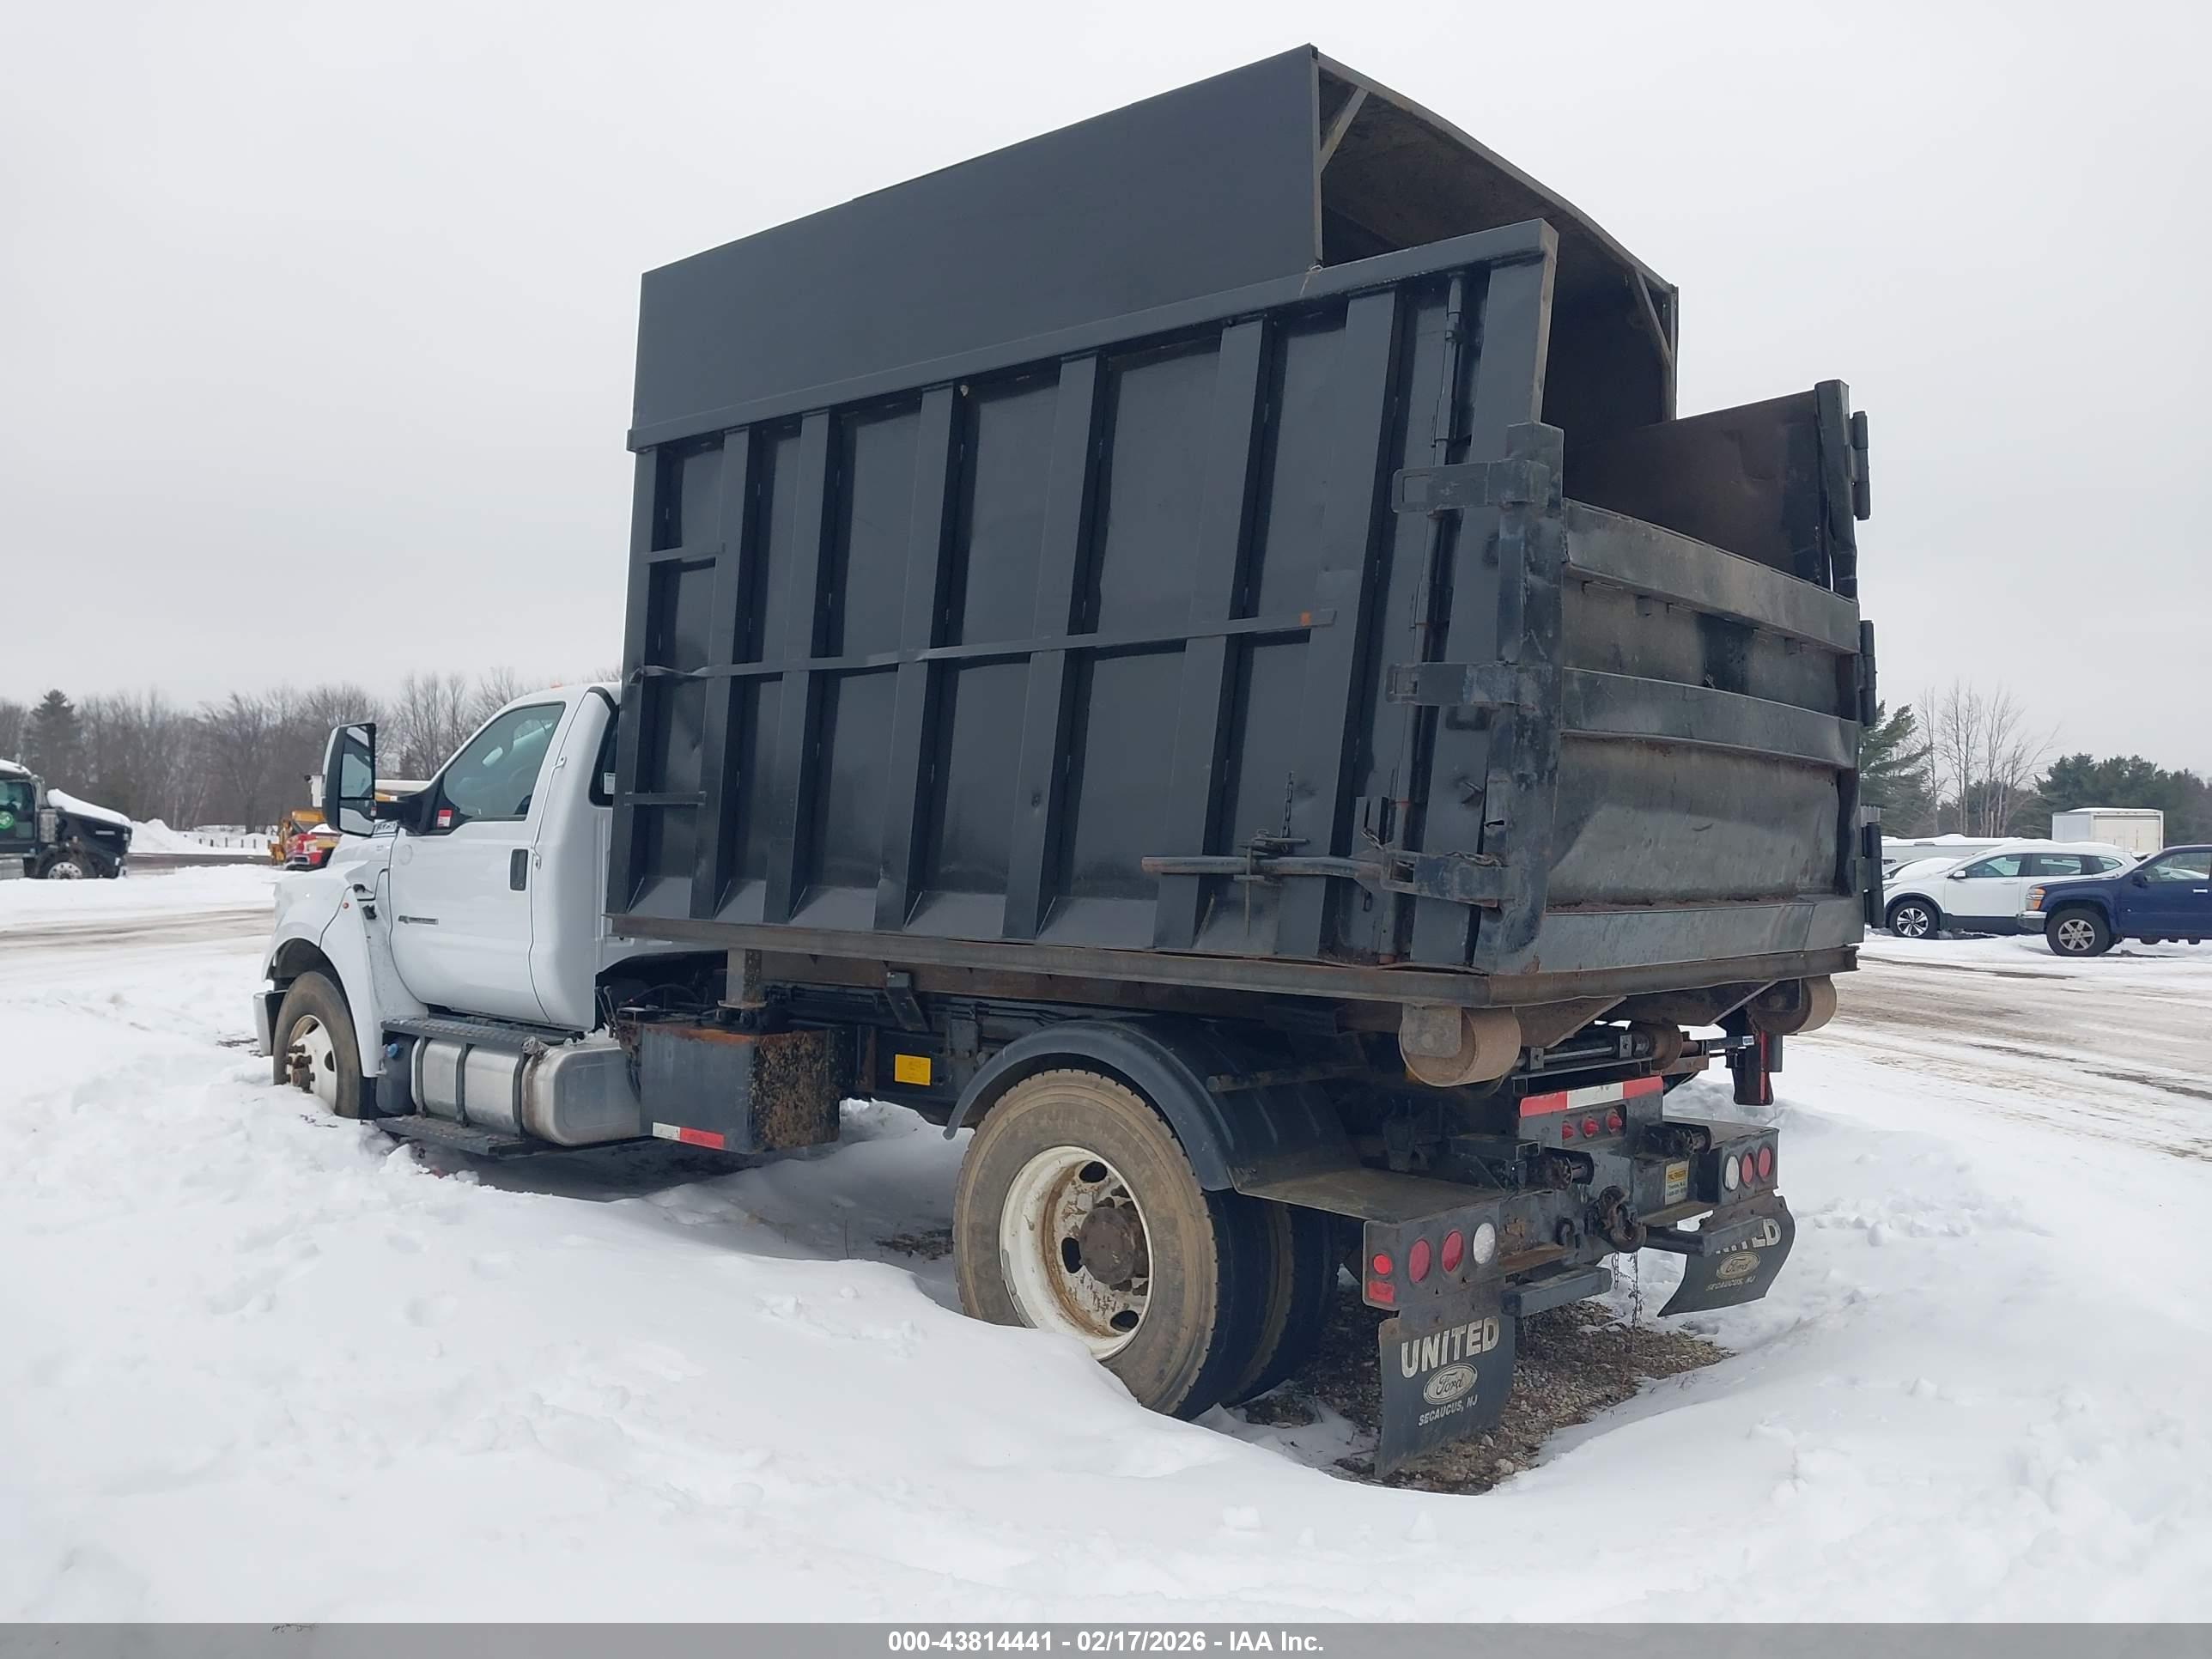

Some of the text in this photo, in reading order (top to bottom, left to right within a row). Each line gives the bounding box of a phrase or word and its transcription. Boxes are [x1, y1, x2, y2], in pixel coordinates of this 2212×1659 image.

[1401, 1316, 1499, 1378] UNITED
[1436, 1371, 1465, 1395] Ford
[1418, 1395, 1478, 1426] SECAUCUS, NJ
